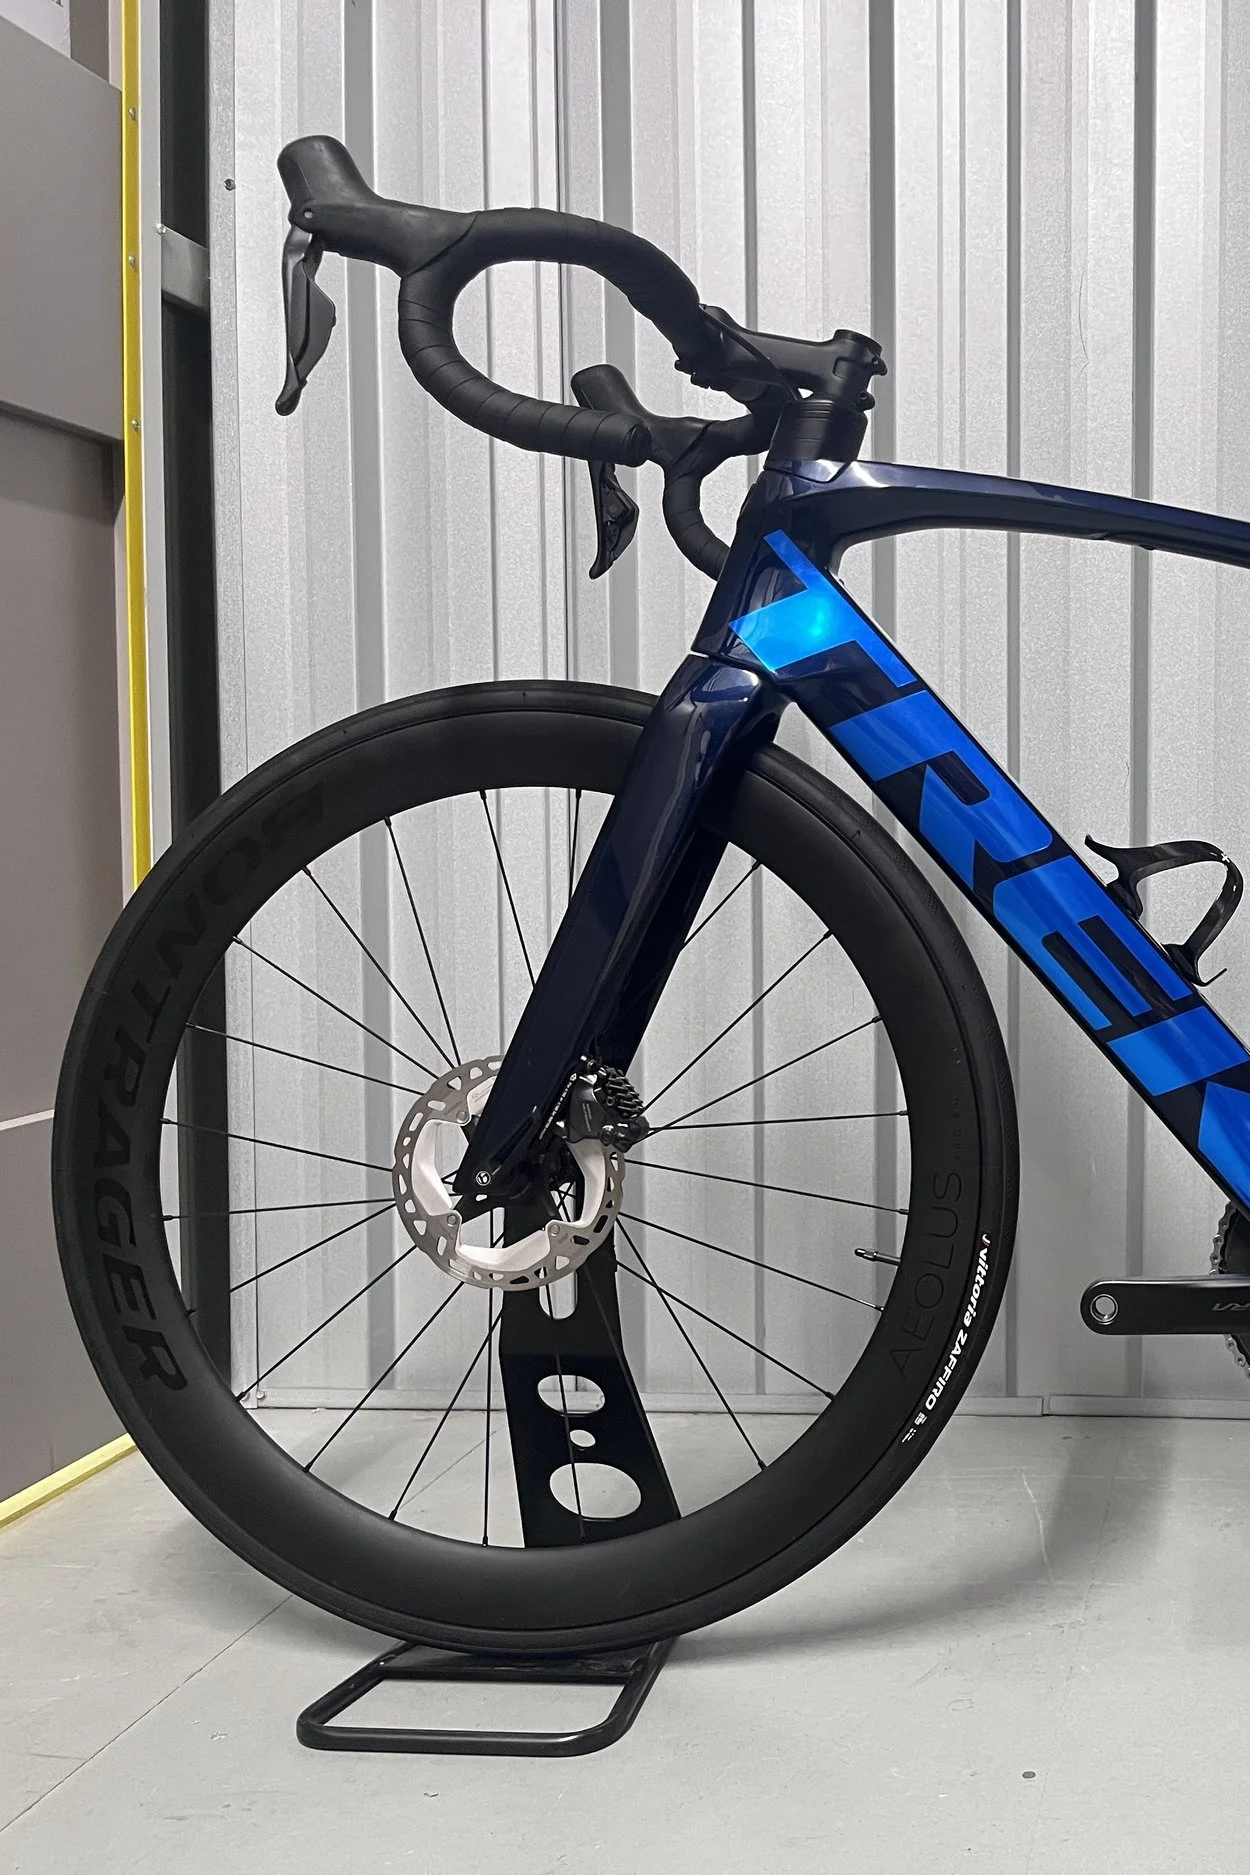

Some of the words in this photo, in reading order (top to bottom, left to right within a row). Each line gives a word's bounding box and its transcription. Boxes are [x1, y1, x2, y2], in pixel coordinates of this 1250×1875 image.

[93, 782, 325, 1392] BONTRAGER
[890, 1172, 962, 1380] AEOLUS
[963, 1247, 989, 1328] vittoria
[925, 1328, 968, 1411] ZAFFIRO
